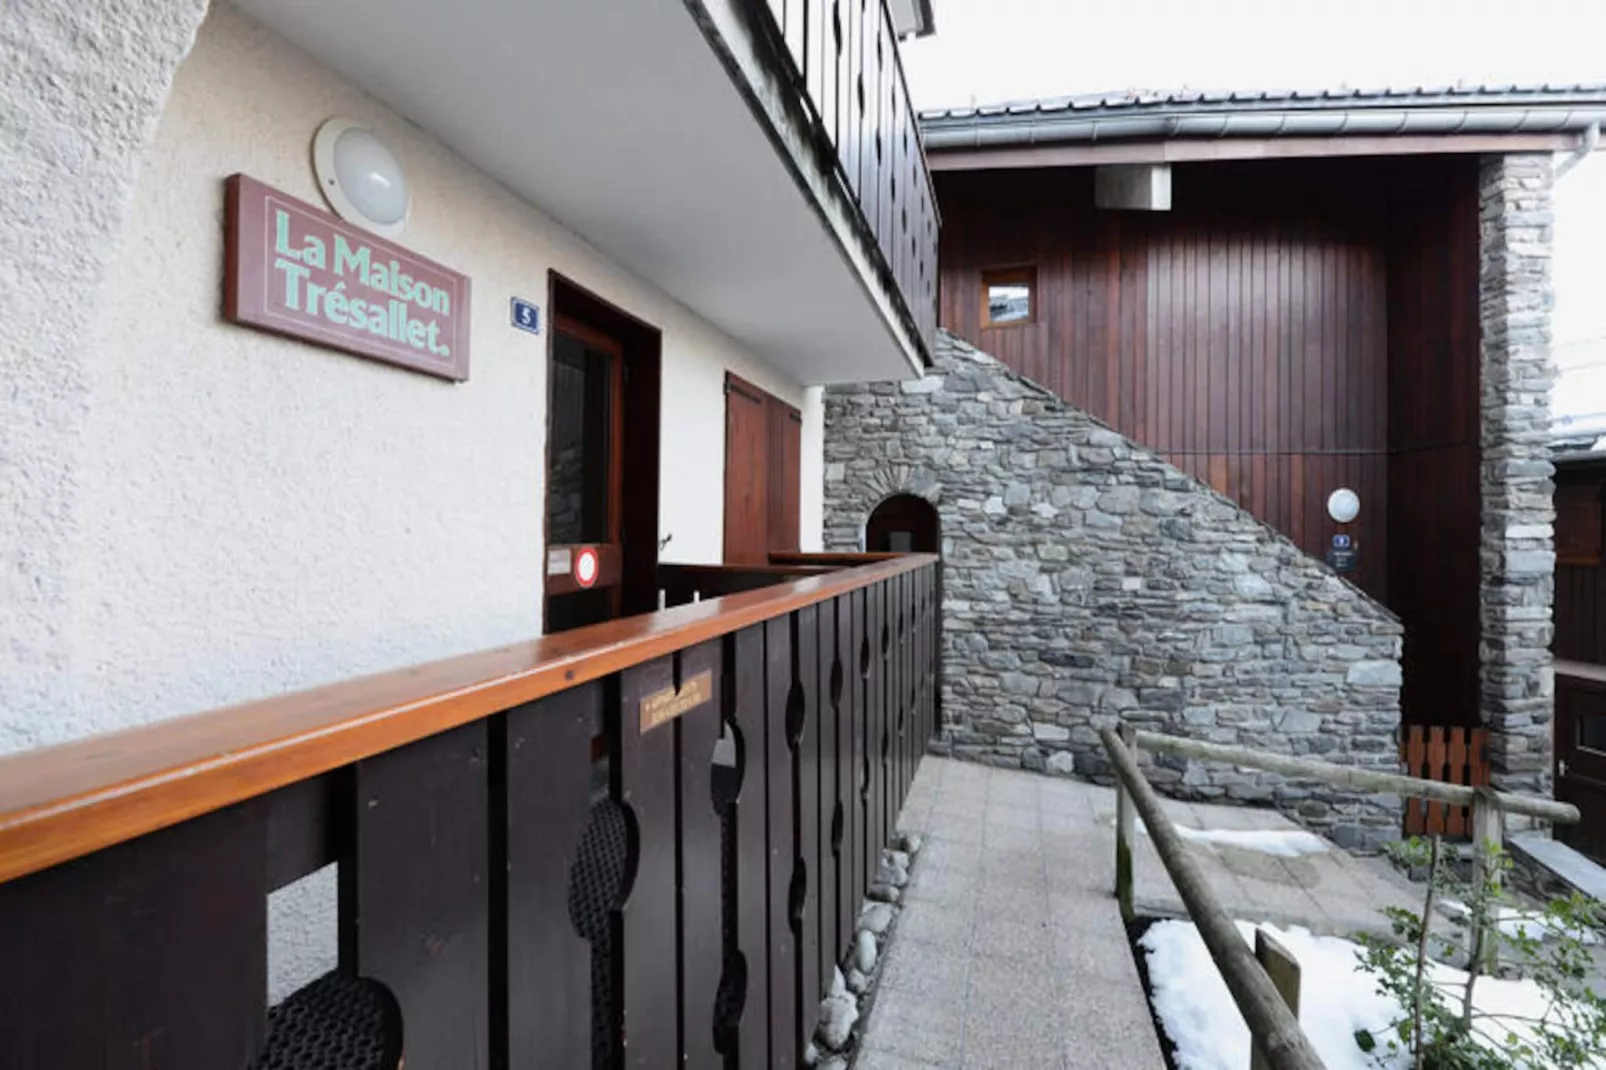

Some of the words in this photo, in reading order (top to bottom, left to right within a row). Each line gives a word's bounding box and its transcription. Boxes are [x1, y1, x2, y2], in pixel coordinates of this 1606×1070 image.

[275, 208, 326, 270] La
[333, 233, 450, 316] Maison
[521, 306, 532, 325] 5
